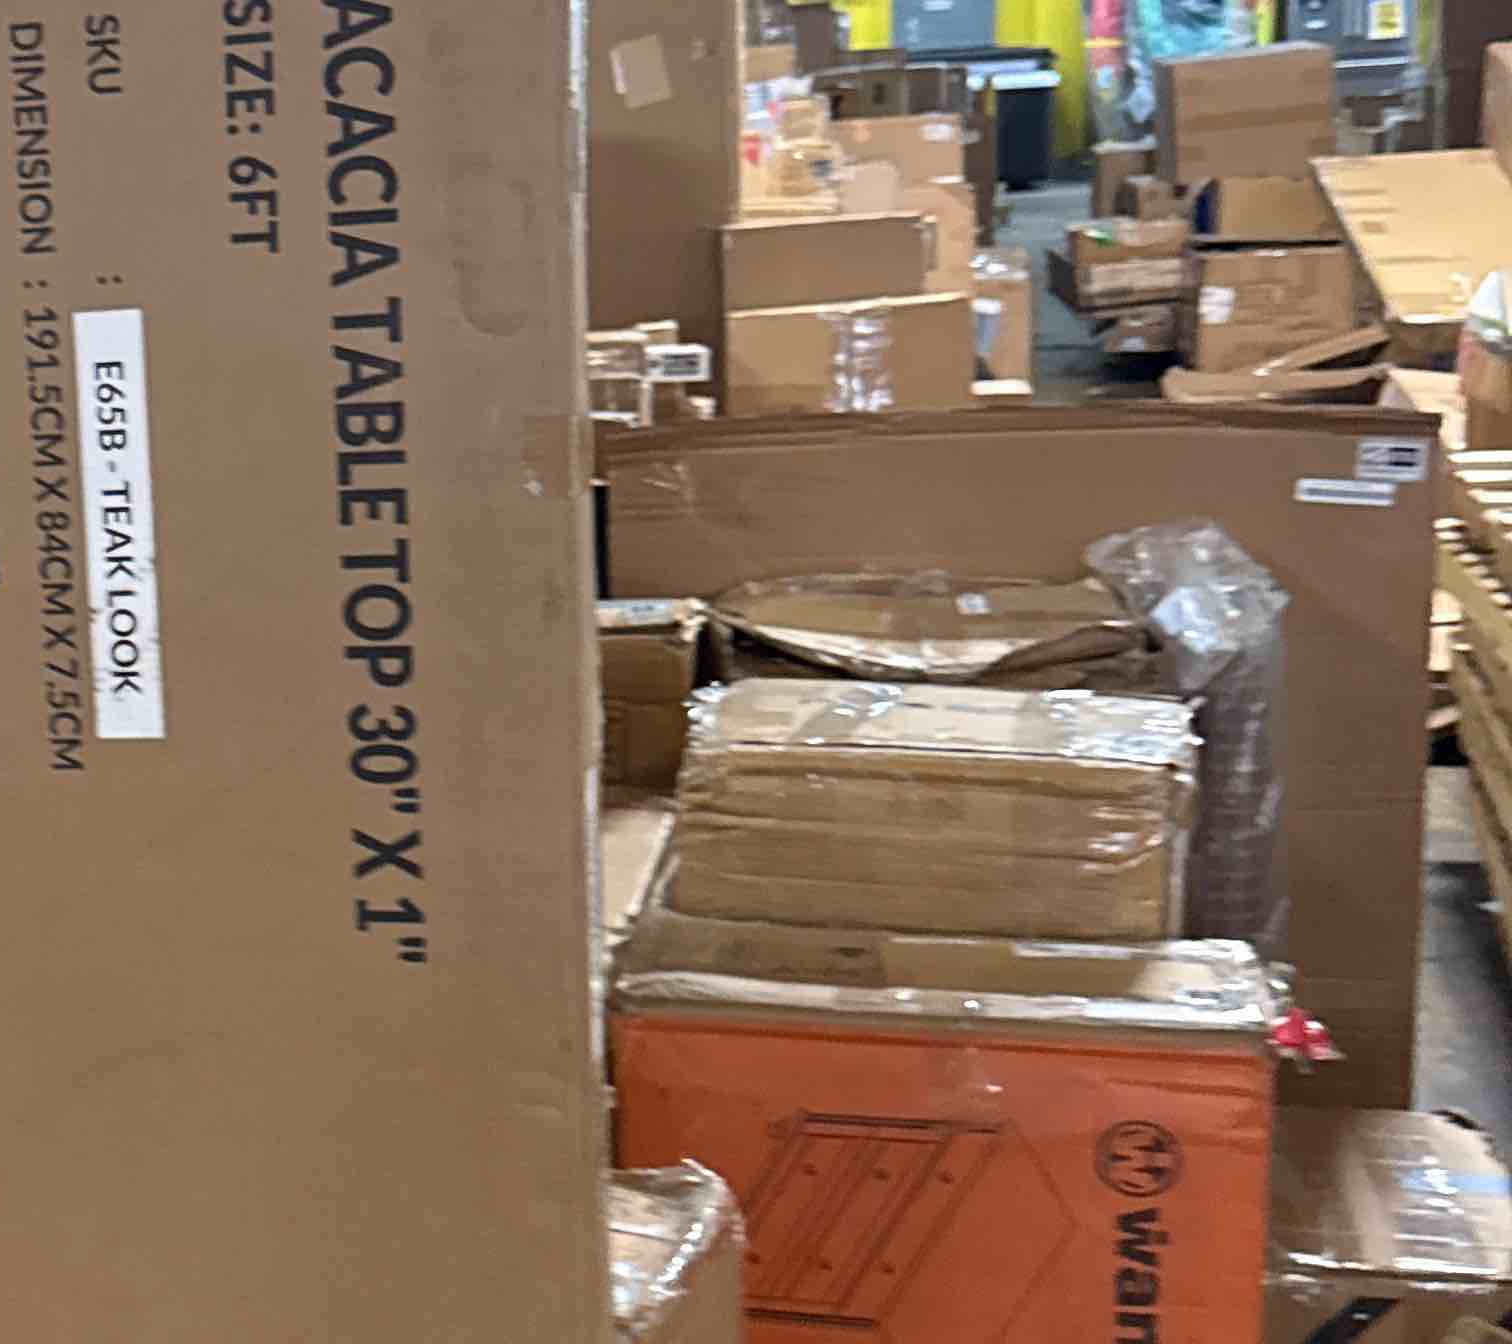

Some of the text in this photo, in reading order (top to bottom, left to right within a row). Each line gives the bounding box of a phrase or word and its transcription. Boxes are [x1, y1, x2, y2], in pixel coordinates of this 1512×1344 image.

[84, 15, 122, 95] SKU
[8, 22, 56, 255] DIMENSION
[227, 156, 280, 254] 6FT
[23, 306, 68, 466] 191.5CM
[93, 361, 127, 450] E65B
[330, 296, 409, 526] TABLE
[35, 479, 71, 500] X
[101, 481, 136, 578] TEAK
[37, 511, 76, 615] 84CM
[341, 538, 414, 688] TOP
[44, 625, 77, 648] X
[106, 590, 142, 694] LOOK
[45, 660, 86, 771] 7.5CM
[347, 704, 422, 814] 30"
[350, 828, 423, 879] X
[354, 897, 427, 964] 1"
